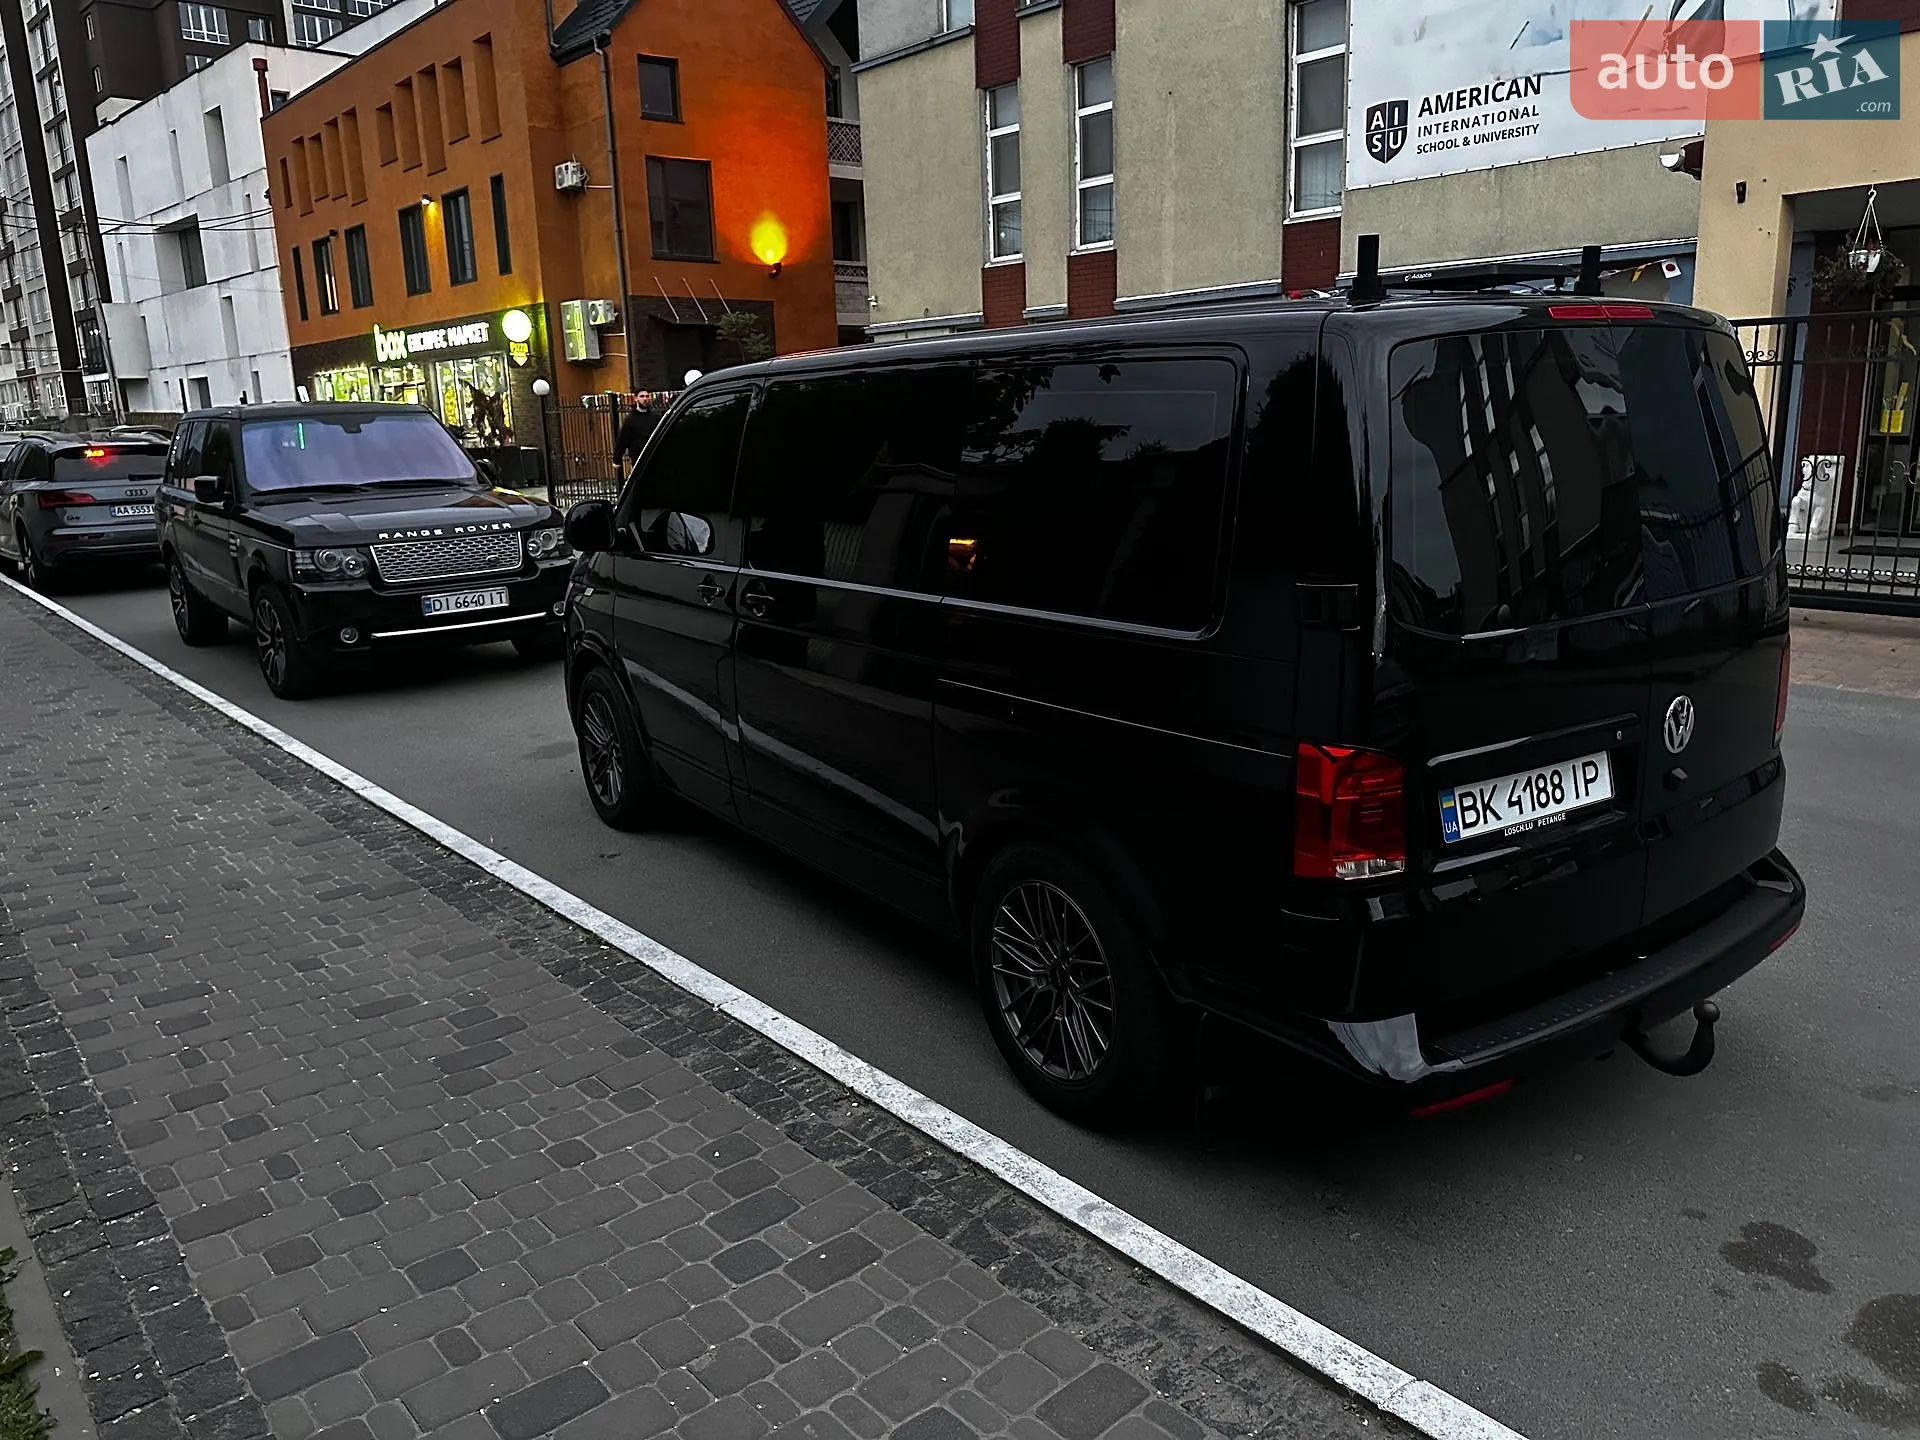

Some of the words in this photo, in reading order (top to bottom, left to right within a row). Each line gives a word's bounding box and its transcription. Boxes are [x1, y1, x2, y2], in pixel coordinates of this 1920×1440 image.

[1417, 74, 1542, 118] AMERICAN
[1417, 104, 1540, 138] INTERNATIONAL
[1416, 137, 1460, 155] SCHOOL
[1462, 136, 1471, 147] &
[1473, 123, 1540, 145] UNIVERSITY
[116, 506, 130, 516] AA
[131, 504, 151, 514] 5553
[378, 529, 443, 540] RANGE
[454, 522, 512, 534] ROVER
[432, 597, 450, 612] DI
[454, 594, 486, 609] 6640
[489, 591, 505, 605] IT
[1458, 783, 1503, 830] BK
[1507, 768, 1565, 815] 4188
[1571, 759, 1599, 800] IP
[1444, 821, 1459, 834] UA
